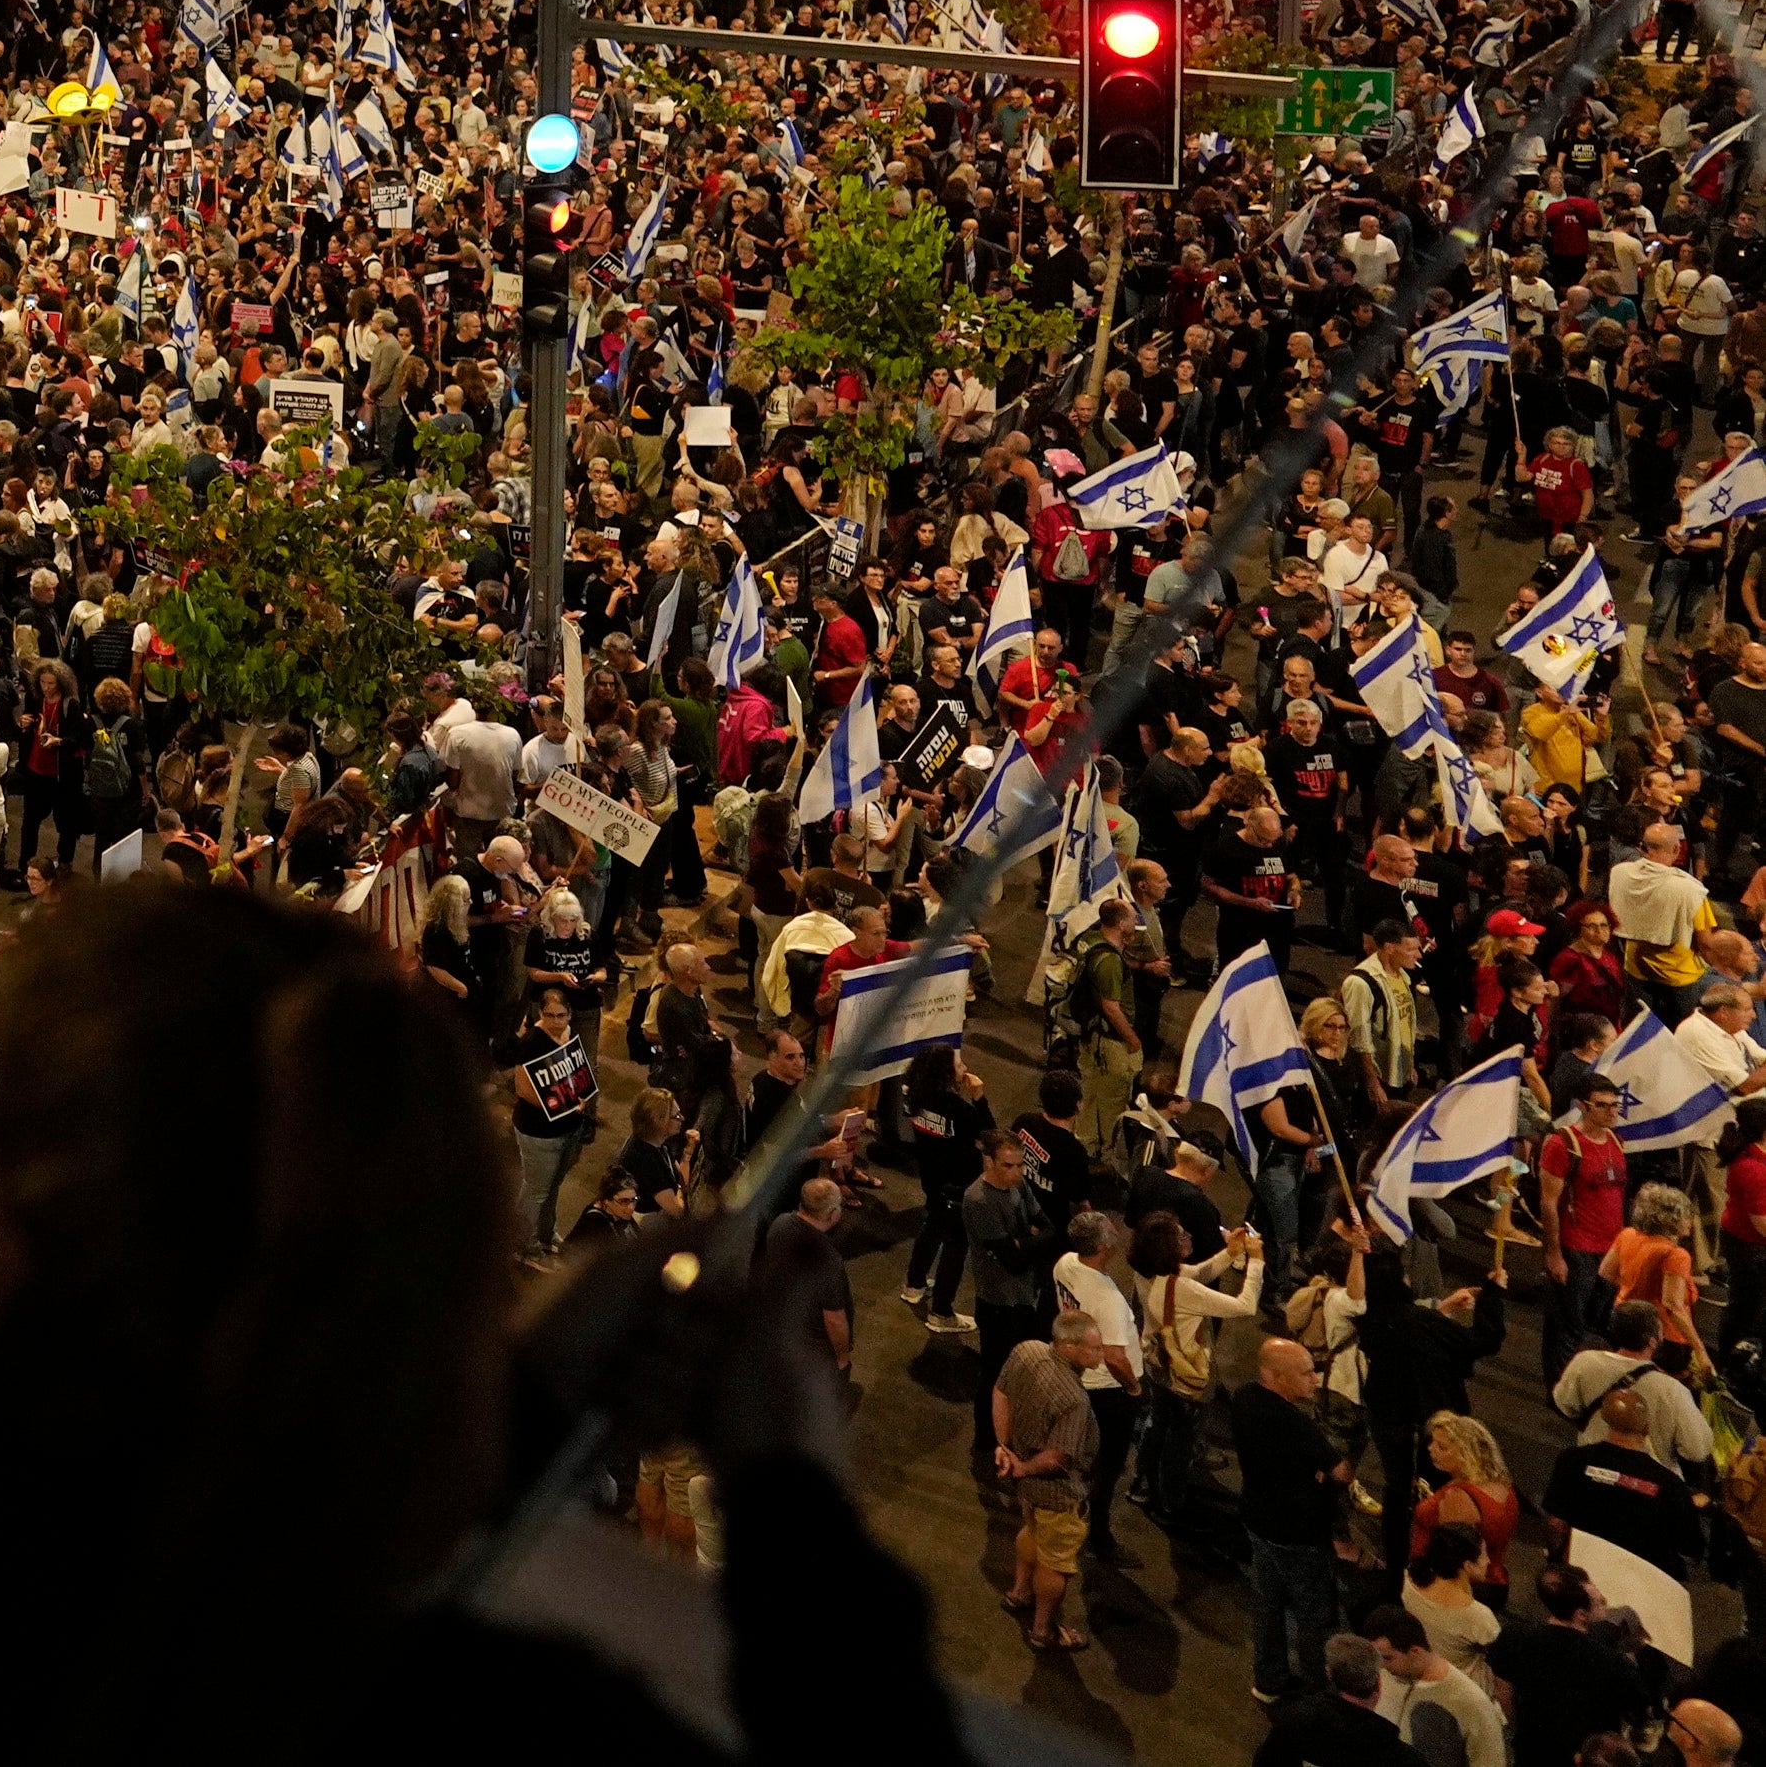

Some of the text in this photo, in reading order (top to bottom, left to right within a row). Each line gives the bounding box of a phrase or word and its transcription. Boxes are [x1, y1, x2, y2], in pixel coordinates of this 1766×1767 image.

[915, 724, 950, 770] עסקה
[551, 770, 577, 790] LET
[575, 785, 597, 804] MY
[571, 1047, 586, 1067] אל
[535, 1069, 551, 1088] לו
